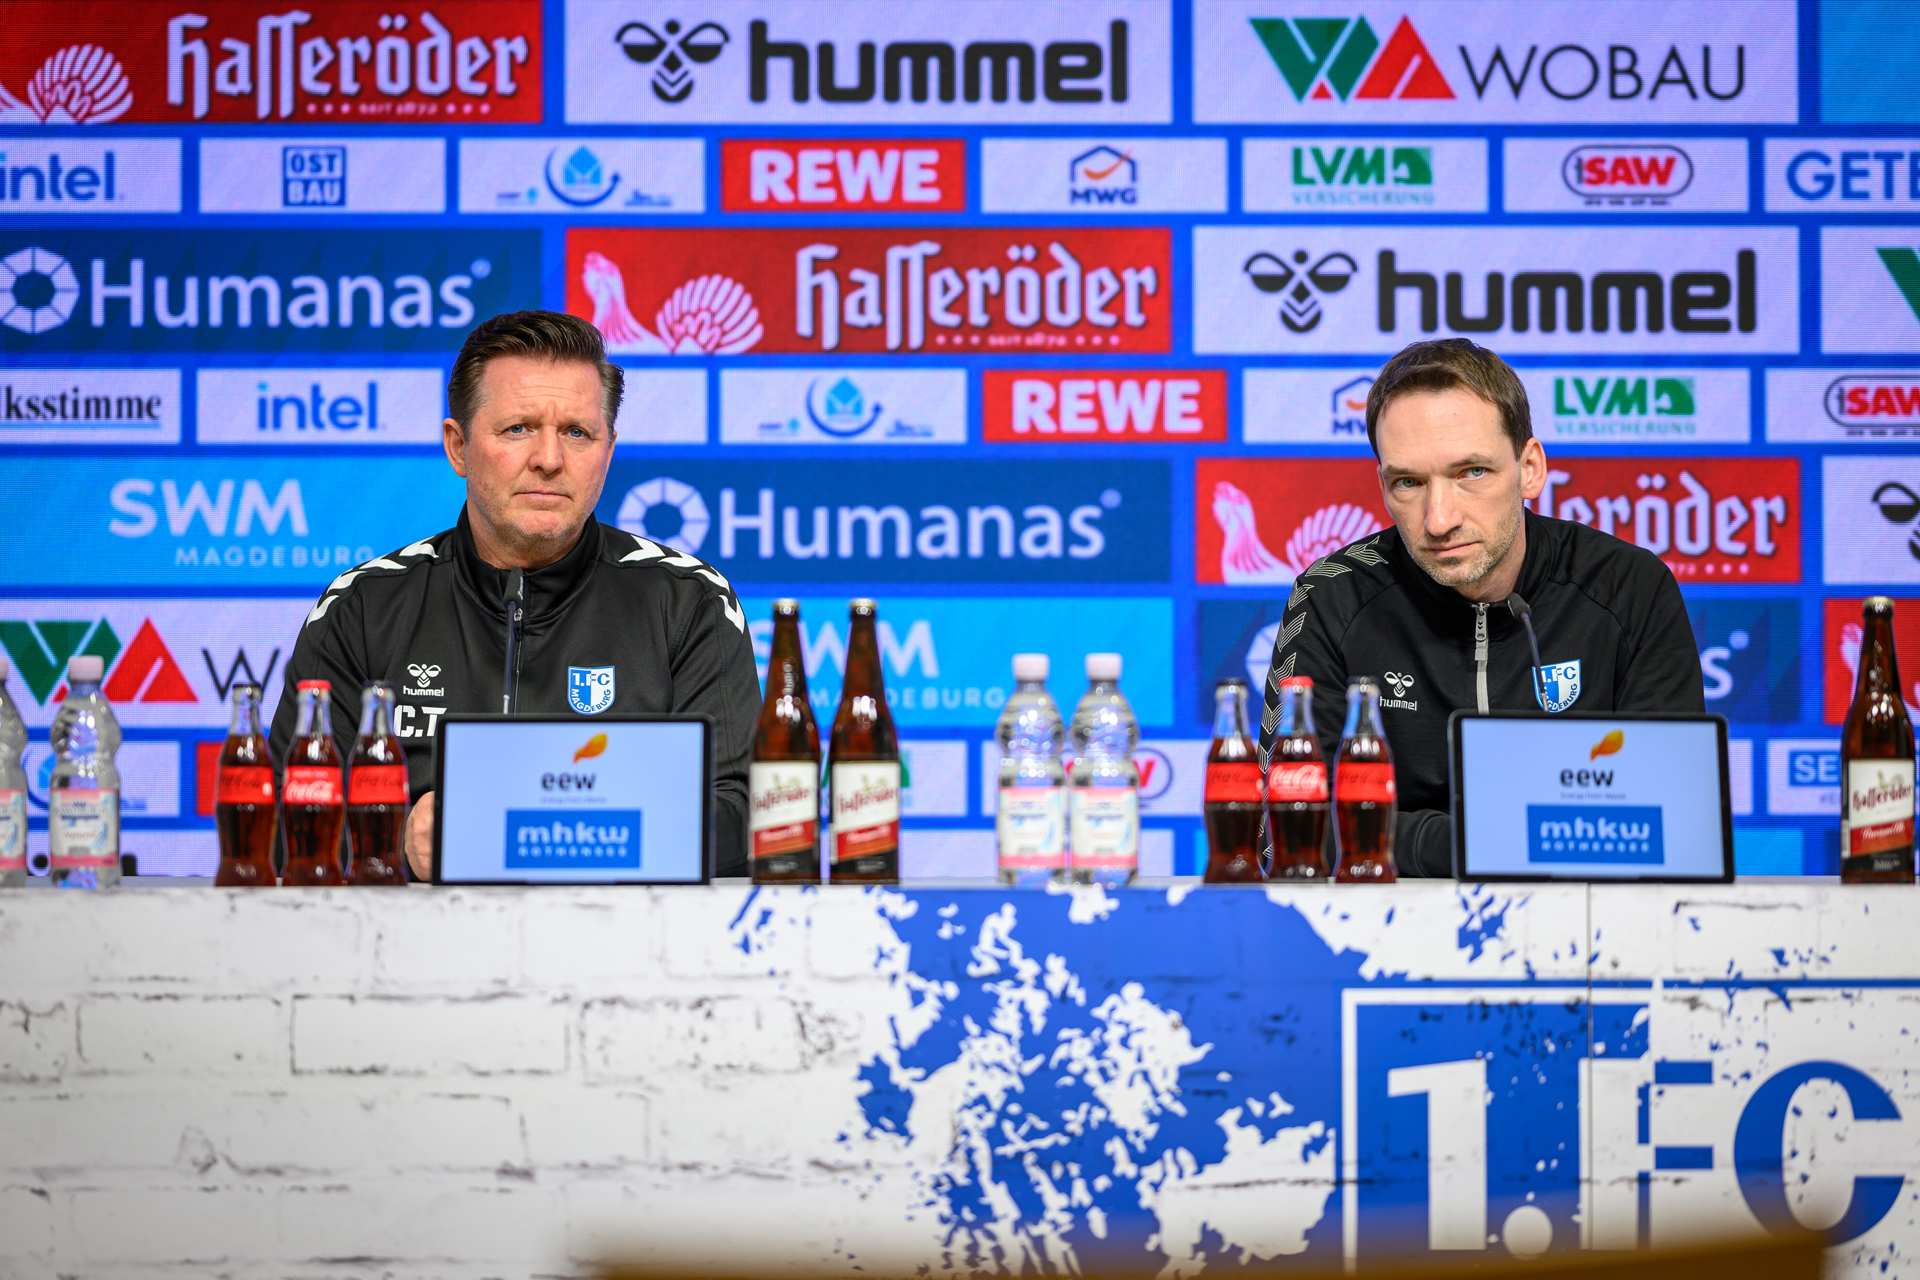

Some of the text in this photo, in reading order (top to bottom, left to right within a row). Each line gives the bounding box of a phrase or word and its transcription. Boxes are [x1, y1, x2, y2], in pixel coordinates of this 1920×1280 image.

[749, 19, 1129, 103] hummel
[1459, 44, 1746, 101] WOBAU
[0, 151, 115, 201] intel
[291, 153, 337, 173] OST
[750, 150, 941, 203] REWE
[1293, 146, 1386, 185] LVM
[1583, 155, 1678, 187] SAW
[289, 180, 341, 203] BAU
[1071, 188, 1136, 204] MWG
[91, 259, 475, 328] Humanas
[1377, 248, 1757, 333] hummel
[256, 381, 378, 432] intel
[1012, 379, 1204, 434] REWE
[1554, 377, 1648, 415] LVM
[108, 479, 309, 538] SWM
[719, 488, 1106, 558] Humanas
[403, 685, 445, 697] hummel
[571, 688, 612, 712] MAGDEBURG
[1380, 695, 1418, 712] hummel
[541, 772, 596, 791] eew
[1559, 768, 1615, 787] eew
[517, 820, 630, 845] mhkw
[1540, 815, 1651, 841] mhkw
